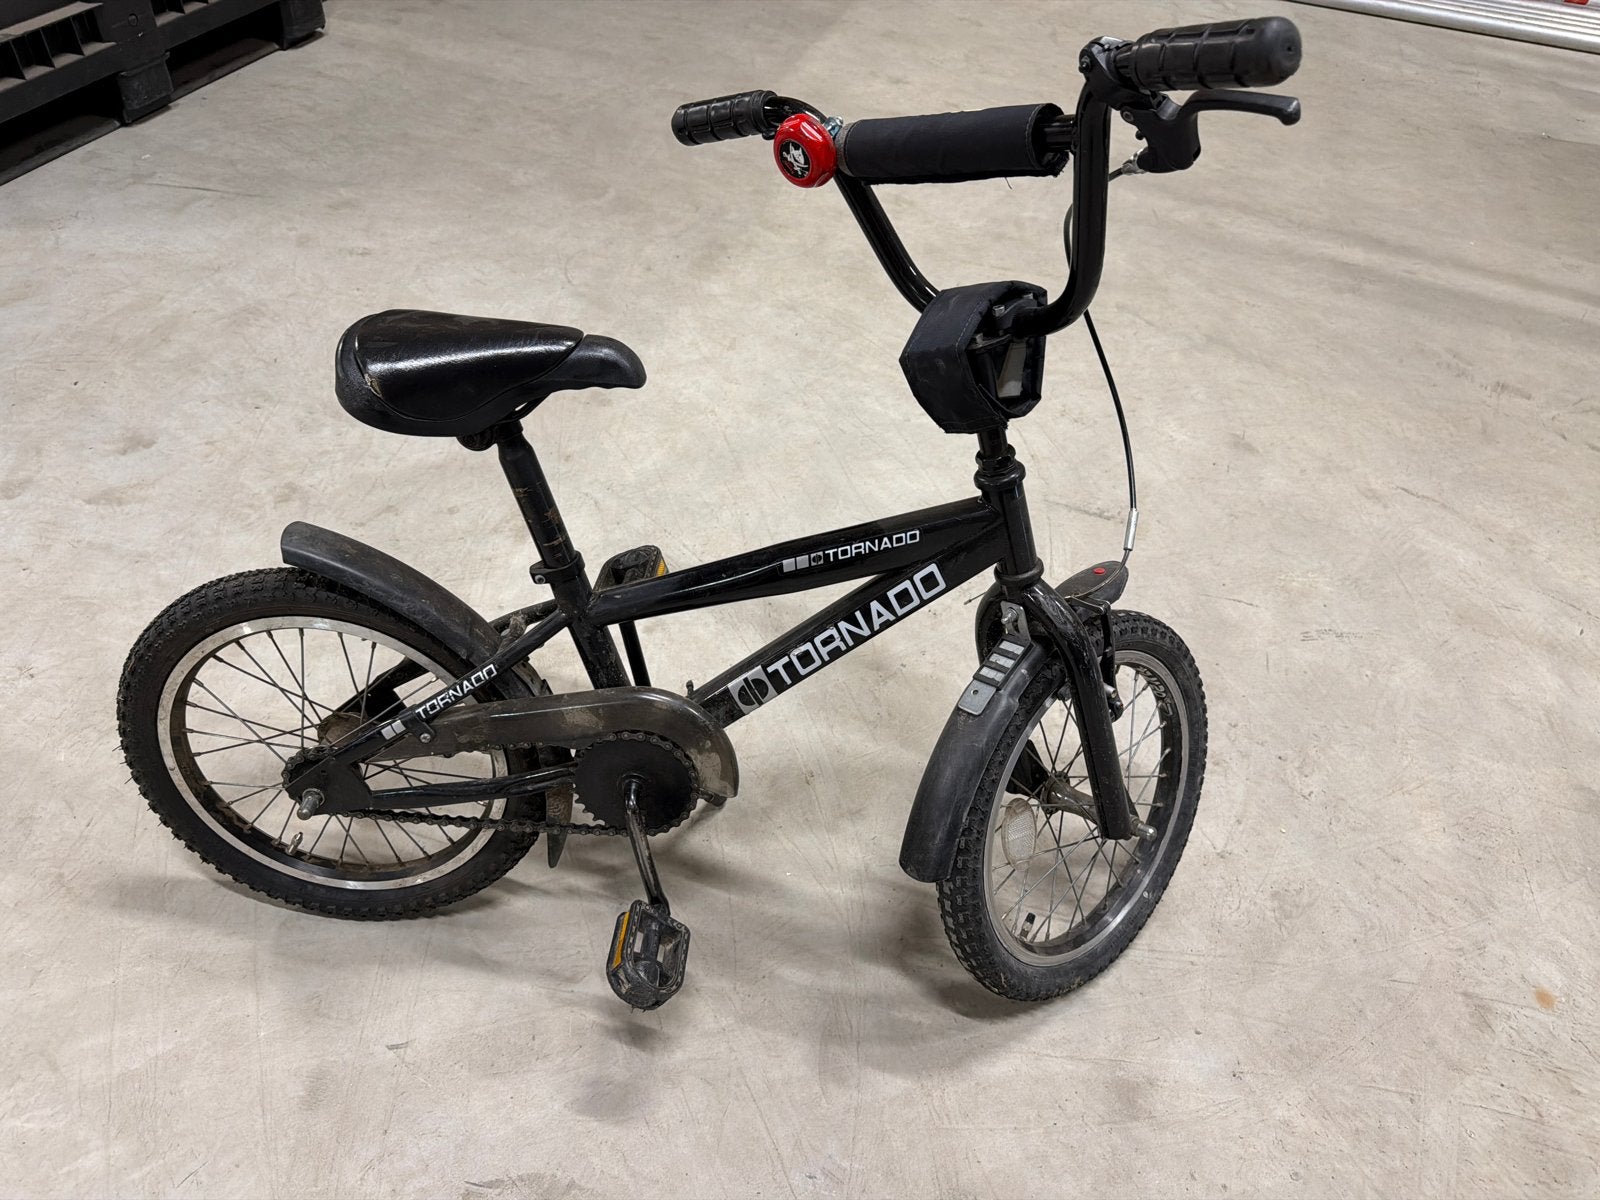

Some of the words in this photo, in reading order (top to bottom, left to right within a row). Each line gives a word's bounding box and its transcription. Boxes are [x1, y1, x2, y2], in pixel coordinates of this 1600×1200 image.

[825, 529, 920, 562] TORNADO
[767, 562, 947, 686] TORNADO
[415, 663, 498, 719] TORNADO
